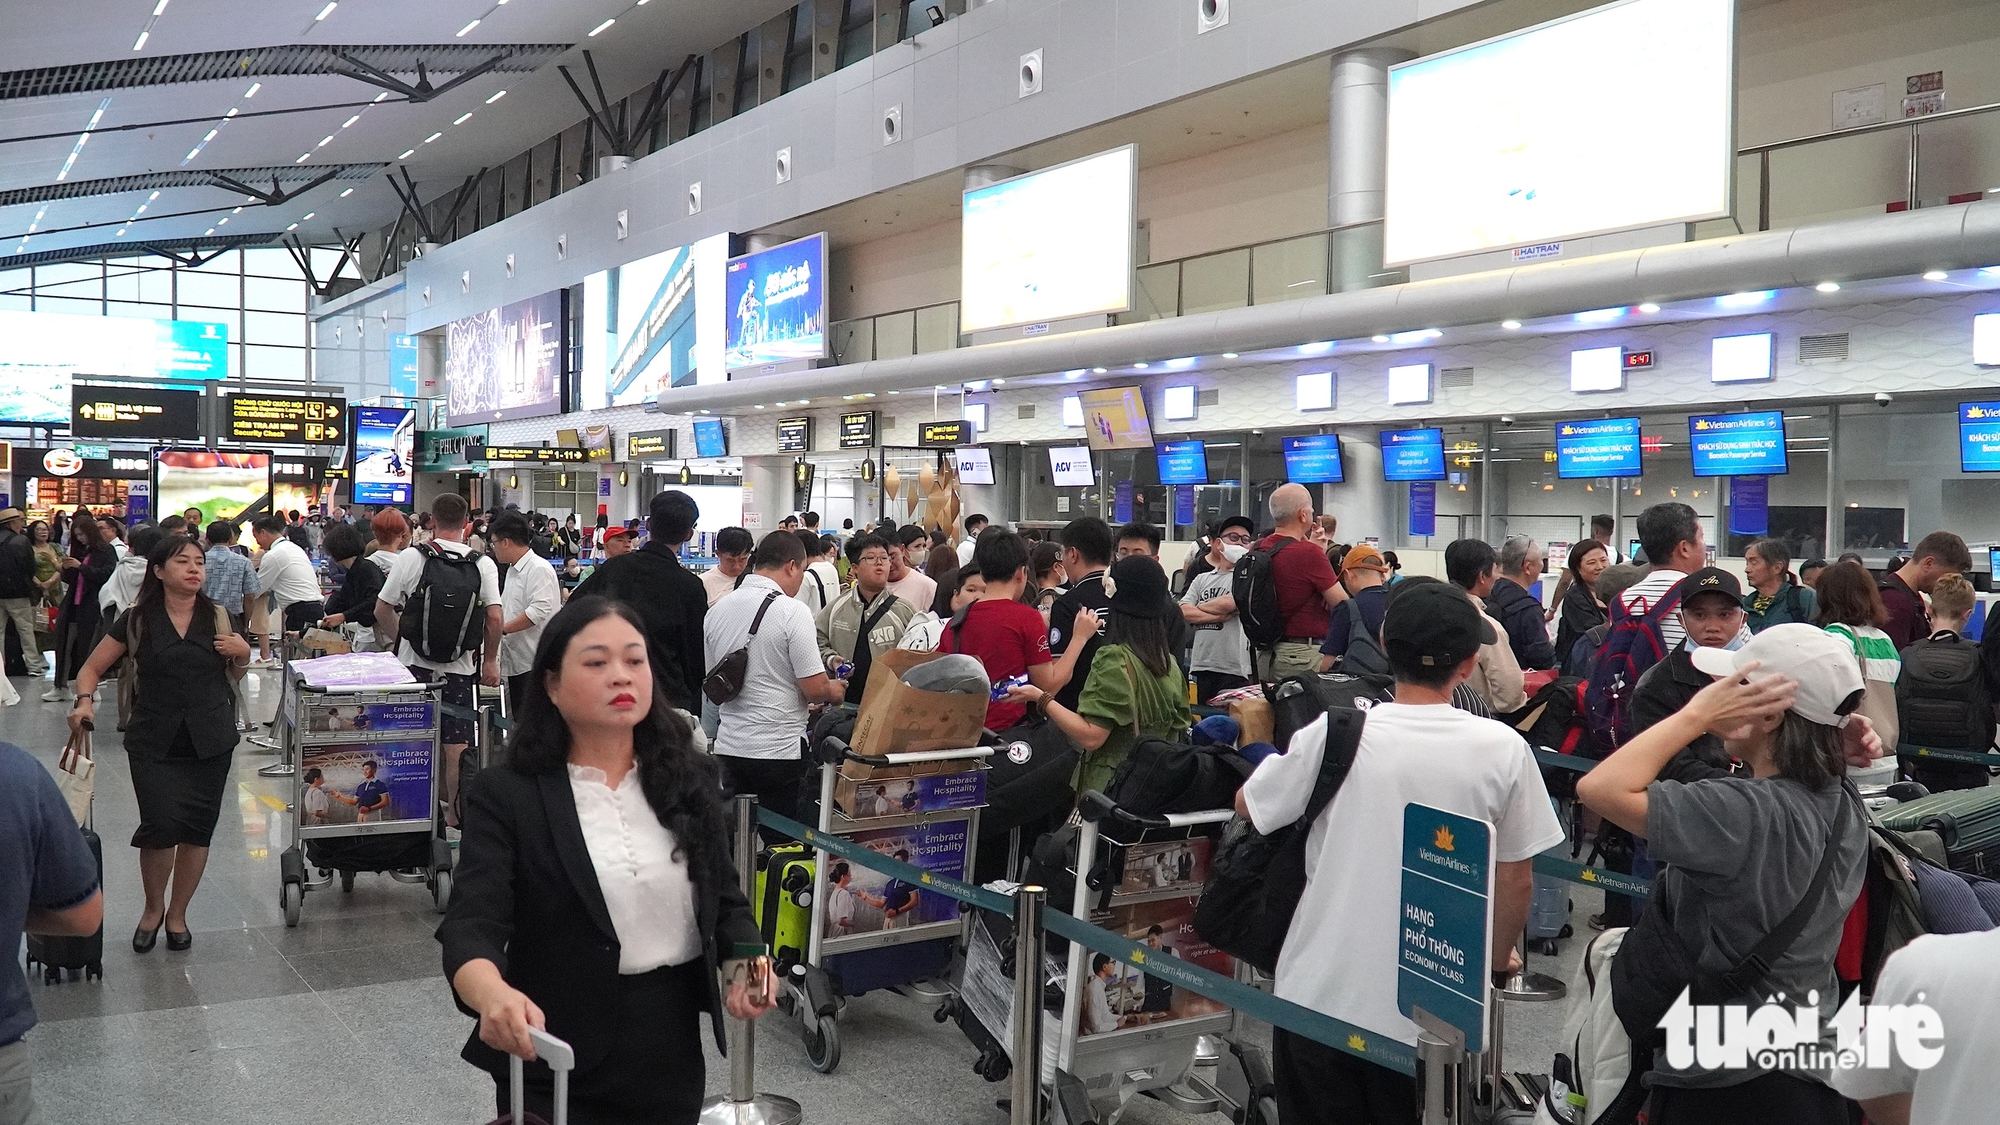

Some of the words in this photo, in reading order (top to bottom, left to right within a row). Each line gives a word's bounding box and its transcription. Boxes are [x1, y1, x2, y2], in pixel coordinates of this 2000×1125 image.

[1708, 421, 1739, 429] Vietnam
[864, 463, 870, 480] 1
[960, 462, 974, 471] ACV
[1055, 462, 1071, 472] ACV
[380, 758, 430, 767] Hospitality
[945, 777, 977, 786] Embrace
[934, 785, 976, 795] Hospitality
[925, 832, 964, 844] Embrace
[912, 842, 964, 856] Hospitality
[1419, 848, 1446, 866] Vietnam
[1446, 856, 1470, 875] Airlines
[931, 877, 952, 890] Vietnam
[952, 884, 971, 898] Airlines
[1596, 874, 1630, 890] Vietnam
[1406, 903, 1434, 927] HẠNG
[1406, 926, 1427, 950] PHỔ
[1428, 936, 1464, 966] THÔNG
[1145, 957, 1176, 975] Vietnam
[1176, 968, 1204, 987] Airlines
[1406, 949, 1440, 972] ECONOMY
[1440, 964, 1464, 984] CLASS
